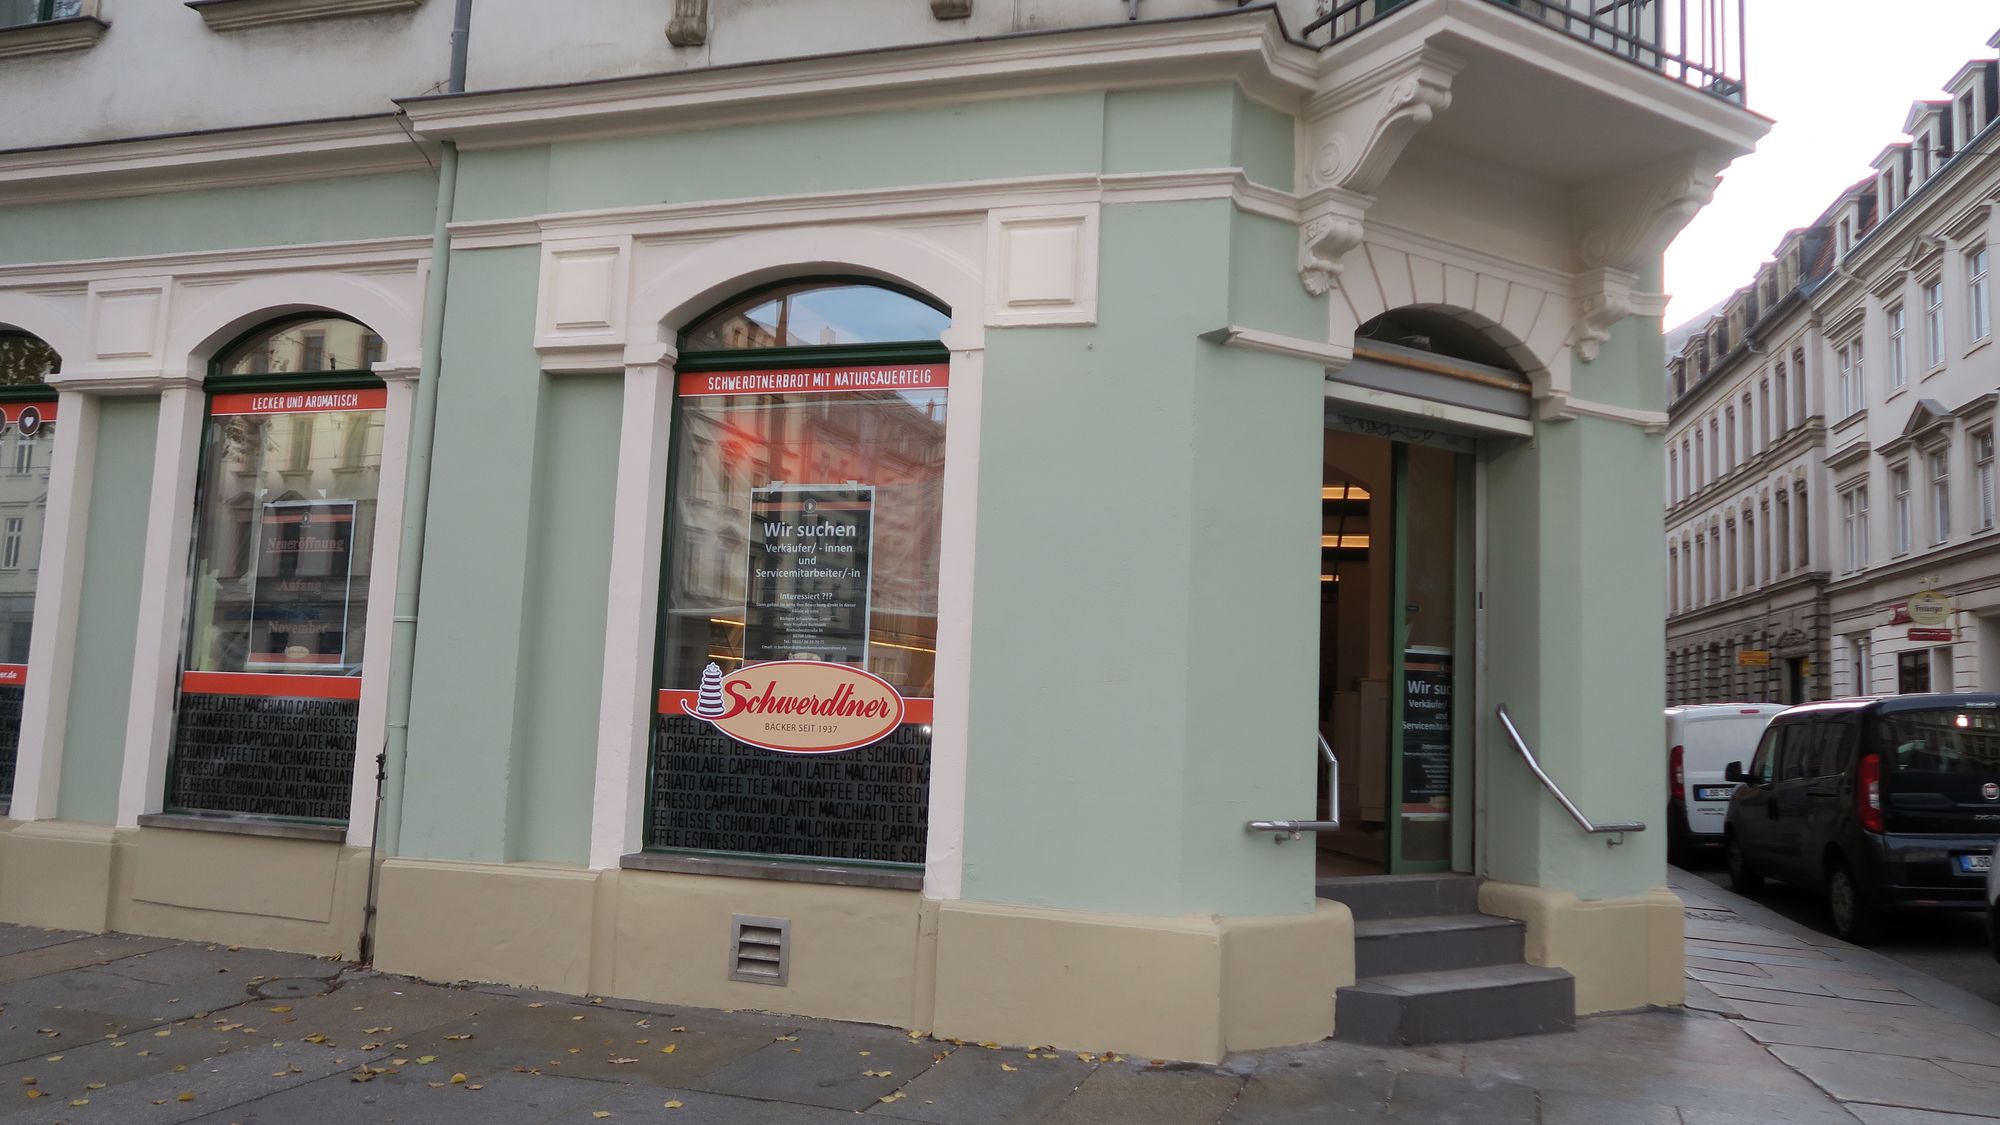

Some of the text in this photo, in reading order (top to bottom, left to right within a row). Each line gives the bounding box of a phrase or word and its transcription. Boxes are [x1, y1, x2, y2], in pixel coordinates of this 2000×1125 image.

[709, 369, 932, 390] SCHWERDTNERBROT MIT NATURSAUERTEIG
[252, 394, 358, 410] LECKER UND AROMATISCH
[764, 520, 856, 537] Wir suchen
[766, 542, 817, 554] Verkäufer/
[825, 543, 853, 553] innen
[798, 556, 817, 565] und
[755, 568, 861, 579] Servicemitarbeiter/-in
[780, 592, 820, 600] Interessiert
[1407, 680, 1431, 694] Wir
[216, 697, 241, 712] LATTE
[244, 698, 293, 714] MACCHIATO
[296, 700, 354, 717] CAPPUCCINO
[722, 679, 891, 719] Schwerdtner
[238, 714, 253, 729] TEE
[257, 715, 304, 731] ESPRESSO
[307, 717, 340, 733] HEISSE
[799, 724, 816, 732] SEIT
[818, 725, 838, 734] 1937
[237, 730, 293, 747] CAPPUCCINO
[297, 734, 323, 749] LATTE
[250, 747, 266, 763] TEE
[269, 749, 330, 767] MILCHKAFFEE
[218, 762, 272, 779] CAPPUCCINO
[275, 766, 301, 782] LATTE
[729, 757, 801, 778] CAPPUCCINO
[806, 762, 841, 780] LATTE
[845, 764, 912, 784] MACCHIATO
[224, 780, 282, 798] SCHOKOLADE
[285, 785, 347, 802] MILCHKAFFEE
[700, 775, 743, 794] KAFFEE
[748, 778, 768, 795] TEE
[771, 779, 852, 800] MILCHKAFFEE
[858, 784, 921, 804] ESPRESSO
[249, 798, 306, 815] CAPPUCCINO
[309, 802, 325, 816] TEE
[704, 794, 777, 814] CAPPUCCINO
[781, 798, 815, 817] LATTE
[819, 801, 886, 821] MACCHIATO
[891, 805, 912, 823] TEE
[671, 811, 711, 829] HEISSE
[716, 814, 790, 835] SCHOKOLADE
[795, 819, 877, 841] MILCHKAFFEE
[685, 831, 744, 850] ESPRESSO
[749, 835, 822, 855] CAPPUCCINO
[826, 840, 847, 857] TEE
[852, 842, 897, 861] HEISSE
